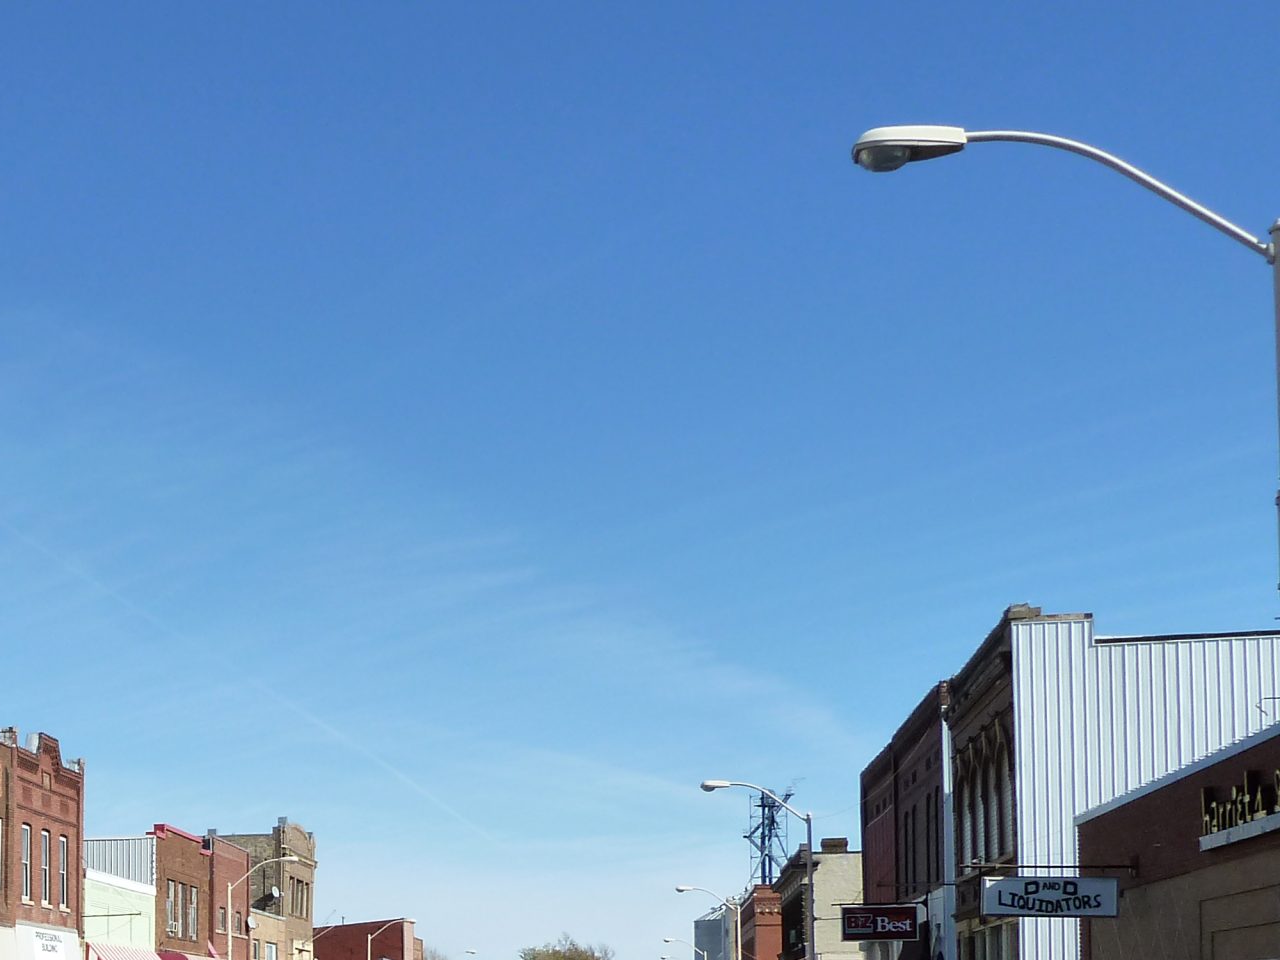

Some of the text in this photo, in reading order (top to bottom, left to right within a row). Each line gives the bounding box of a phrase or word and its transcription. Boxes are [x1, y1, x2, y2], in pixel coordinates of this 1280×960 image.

[1024, 880, 1078, 896] D AND D
[998, 889, 1102, 914] LIQUIDATORS
[875, 916, 913, 932] Best
